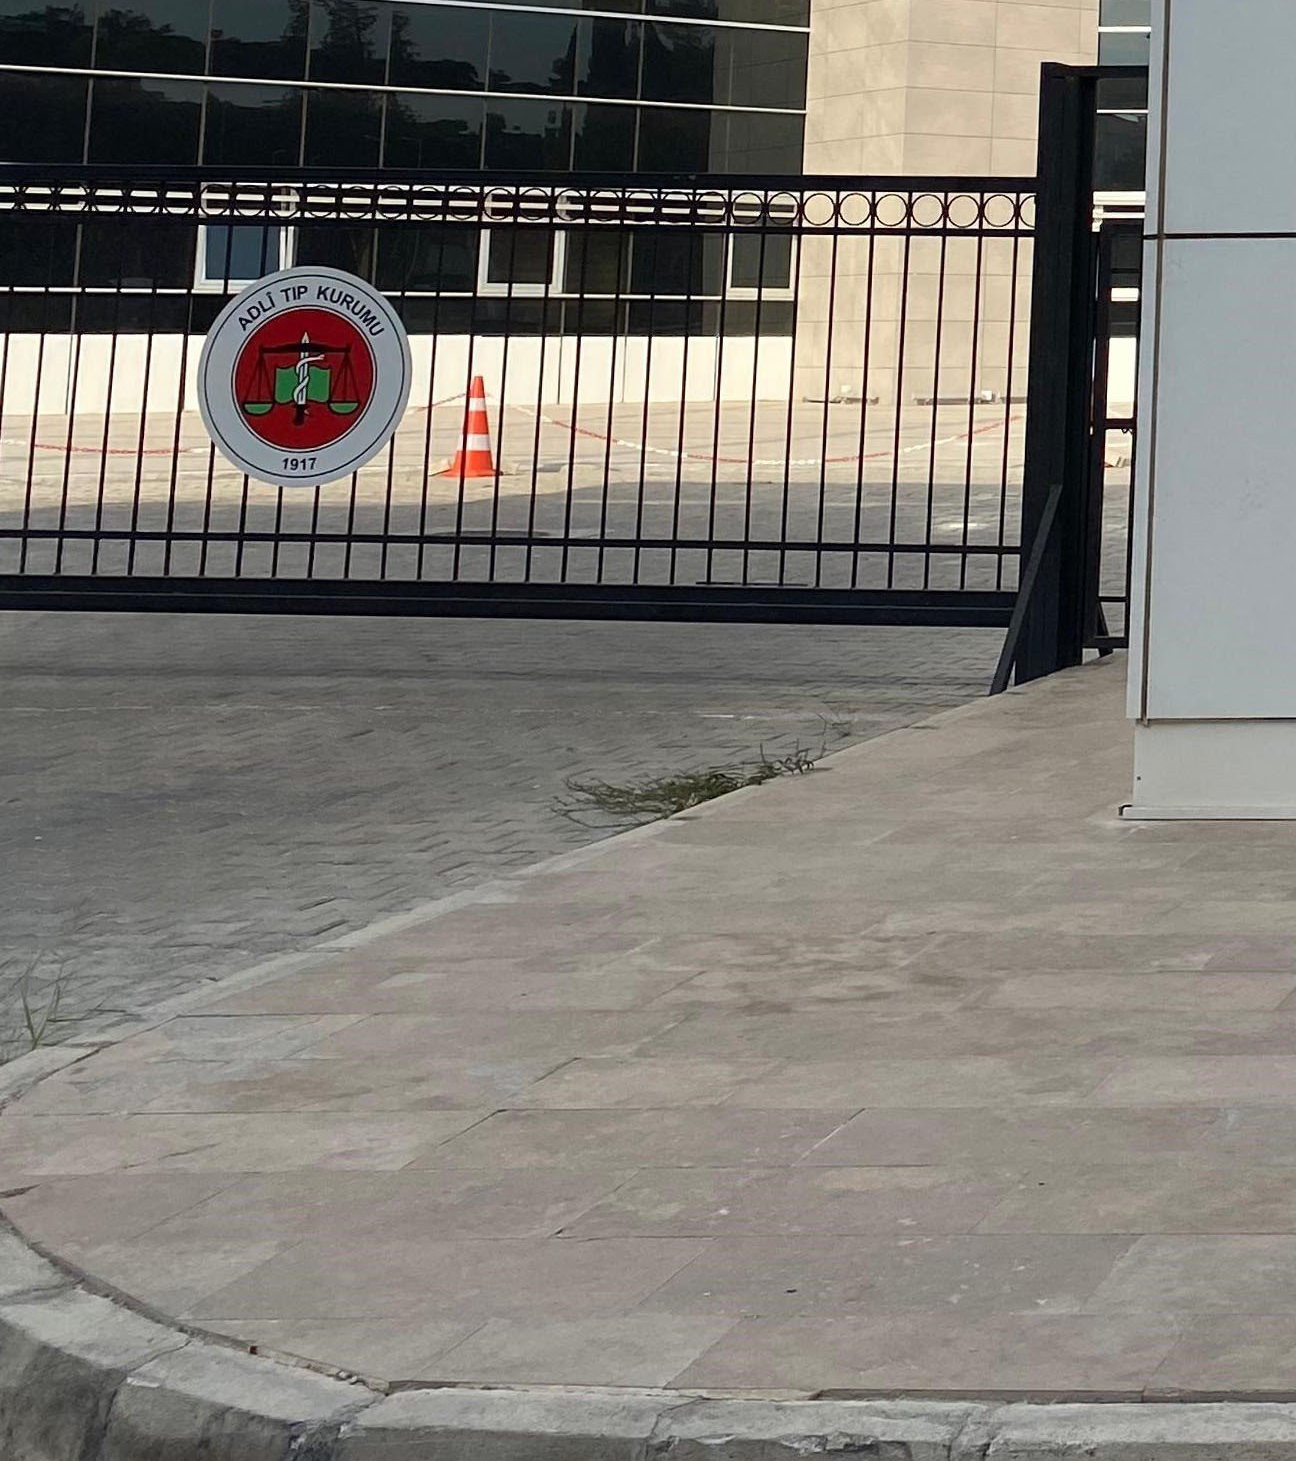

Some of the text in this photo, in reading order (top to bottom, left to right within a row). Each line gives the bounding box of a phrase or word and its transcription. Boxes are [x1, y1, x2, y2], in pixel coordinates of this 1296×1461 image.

[280, 285, 308, 302] TIP
[316, 285, 385, 337] KURUMU
[282, 457, 317, 471] 1917
